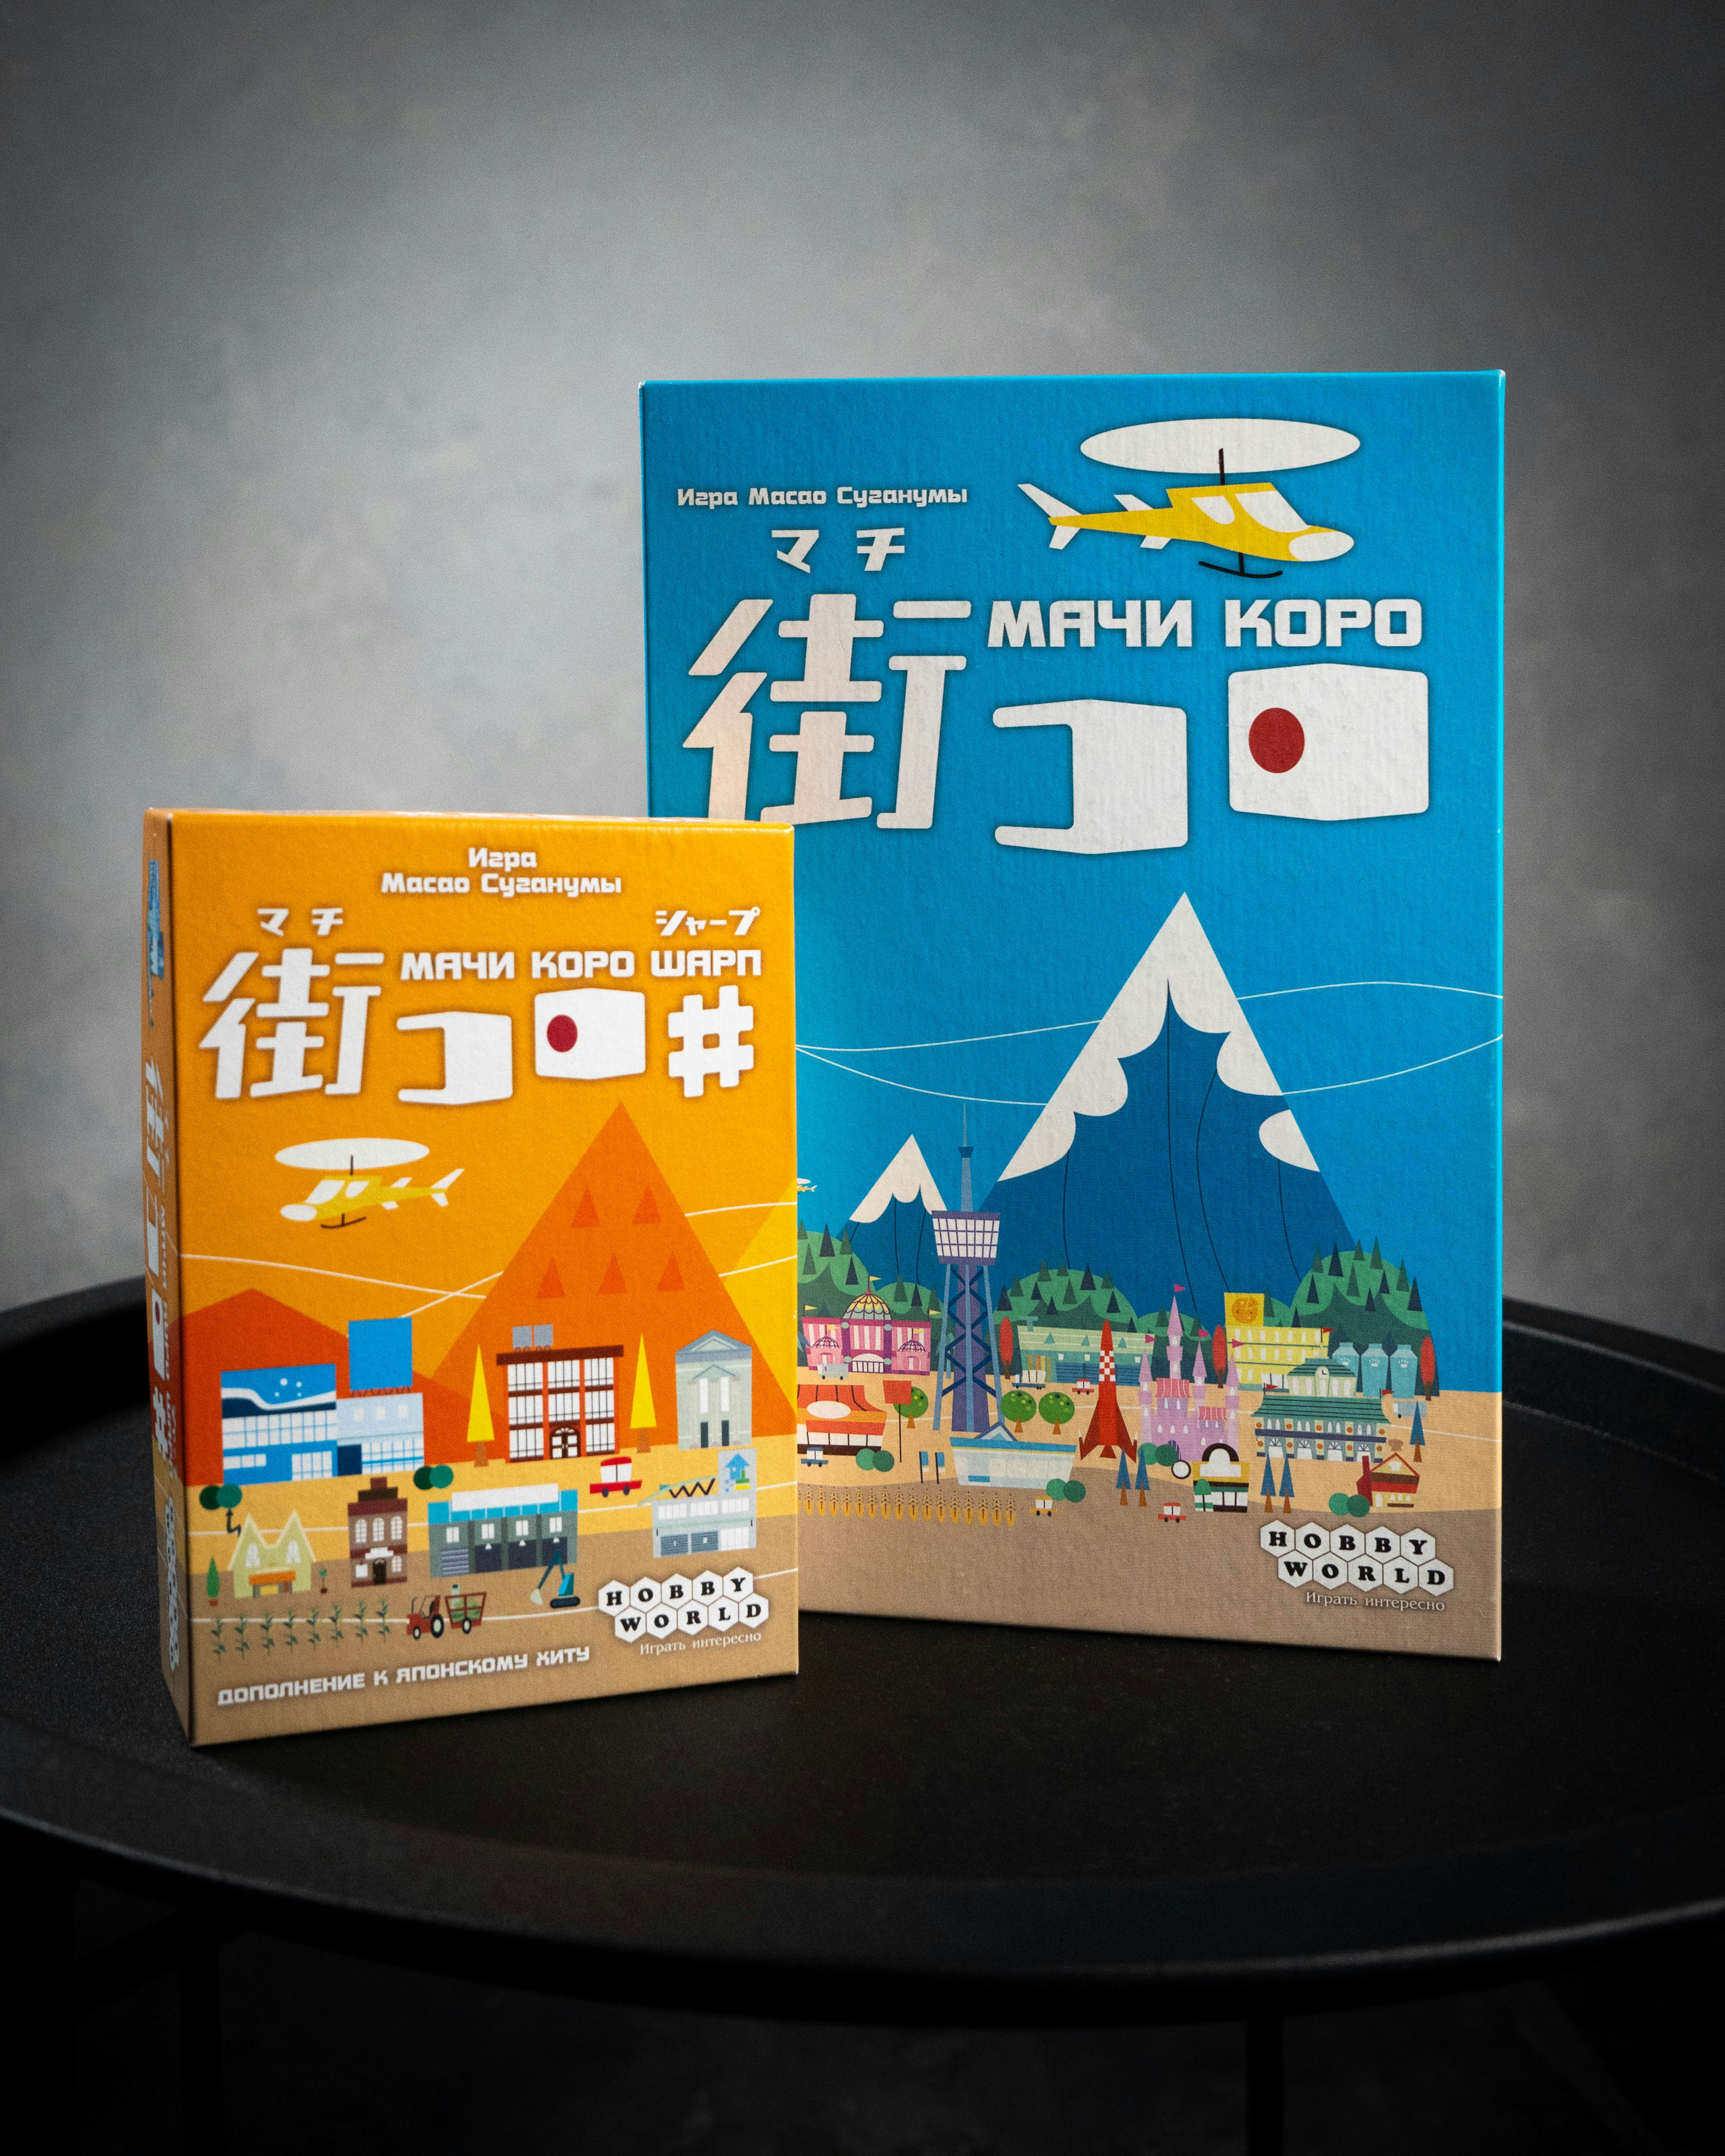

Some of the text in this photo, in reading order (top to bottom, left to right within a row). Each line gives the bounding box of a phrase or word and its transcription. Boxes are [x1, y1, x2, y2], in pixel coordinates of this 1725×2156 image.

[677, 486, 967, 509] Игра Масао Суганумы
[988, 599, 1422, 648] МАЧИ КОРО
[468, 848, 537, 872] Игра
[381, 873, 622, 898] Масао Суганумы
[656, 906, 761, 936] シャープ
[400, 950, 762, 980] МАЧИ КОРО ШАРП
[1268, 1531, 1428, 1555] HOBBY
[1283, 1561, 1446, 1586] WORLD
[606, 1576, 746, 1607] HOBBY
[1306, 1591, 1446, 1611] Играть интересно
[620, 1603, 762, 1632] WORLD
[640, 1632, 762, 1656] Играть интересно
[217, 1646, 590, 1706] ДОПОЛНЕНИЕ К ЯПОНСКОМУ ХИТУ
